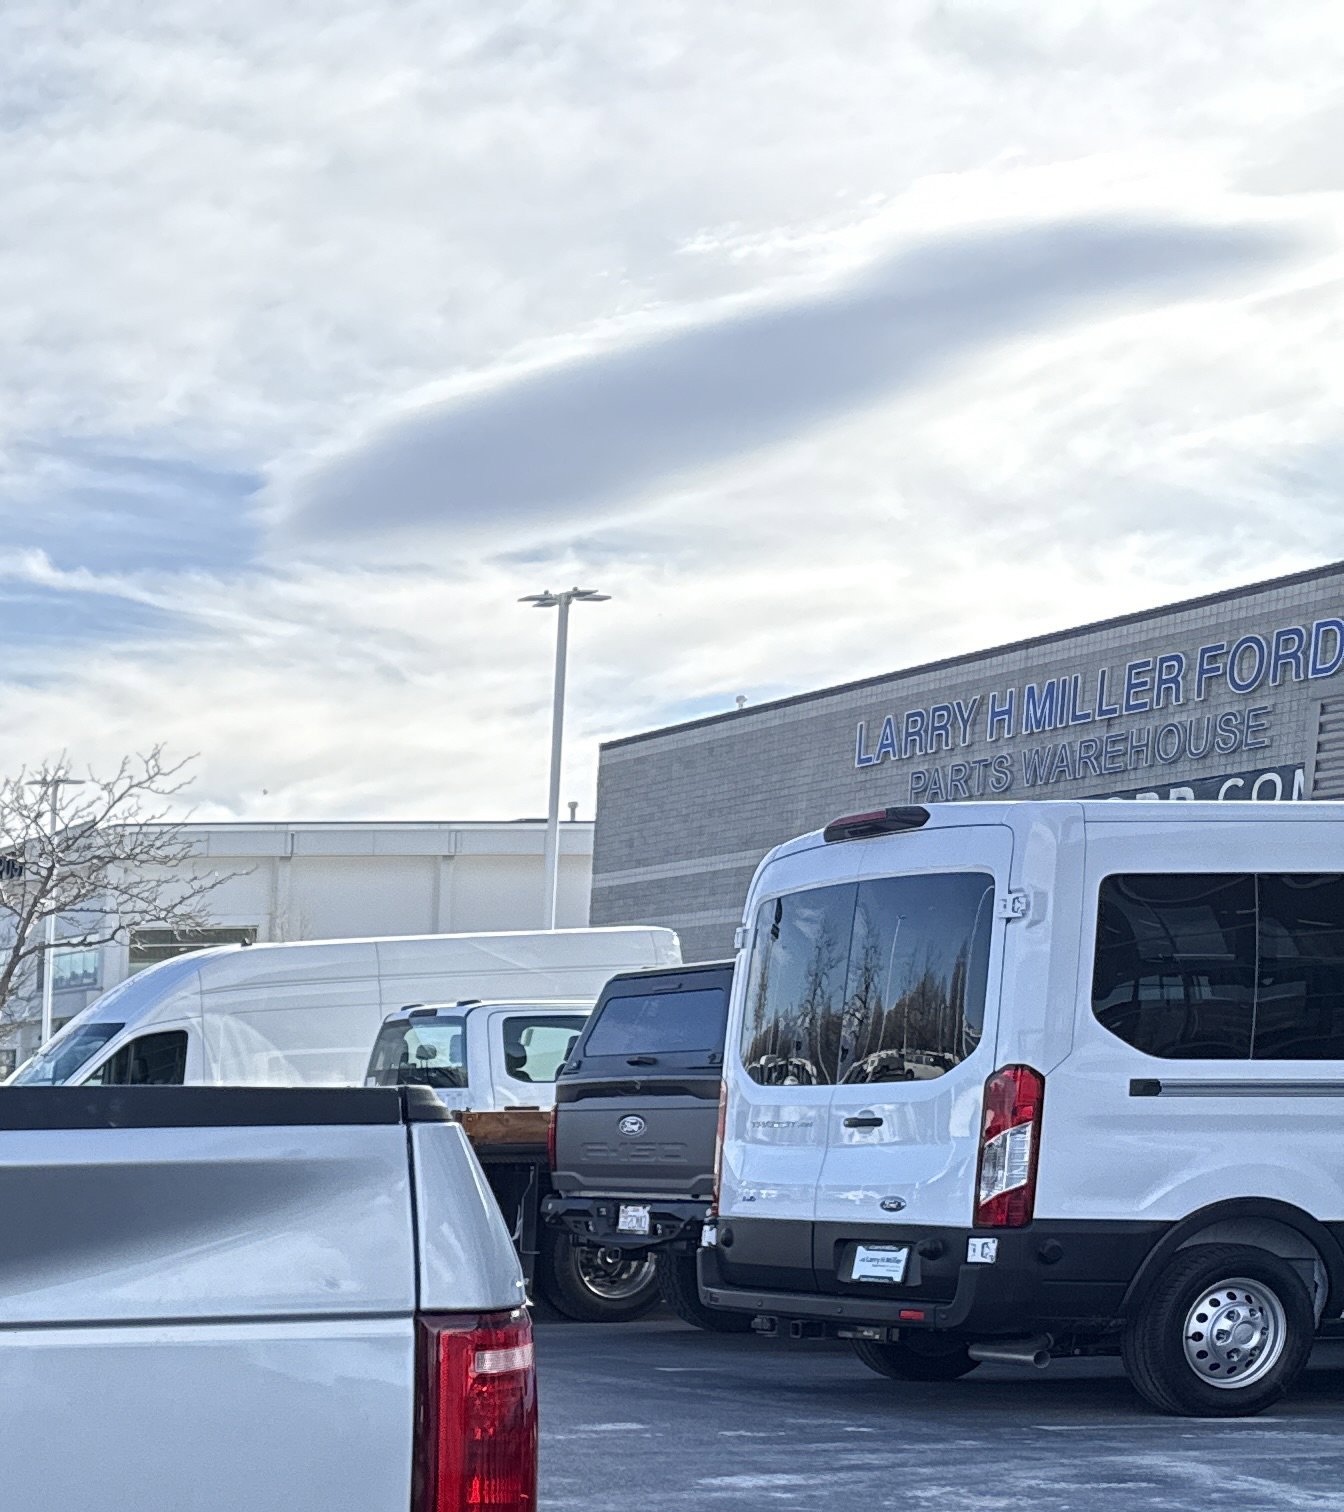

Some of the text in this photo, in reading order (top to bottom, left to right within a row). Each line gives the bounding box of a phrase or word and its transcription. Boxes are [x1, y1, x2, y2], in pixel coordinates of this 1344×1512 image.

[855, 617, 1344, 768] LARRY H MILLER FORD
[909, 704, 1274, 802] PARTS WAREHOUSE
